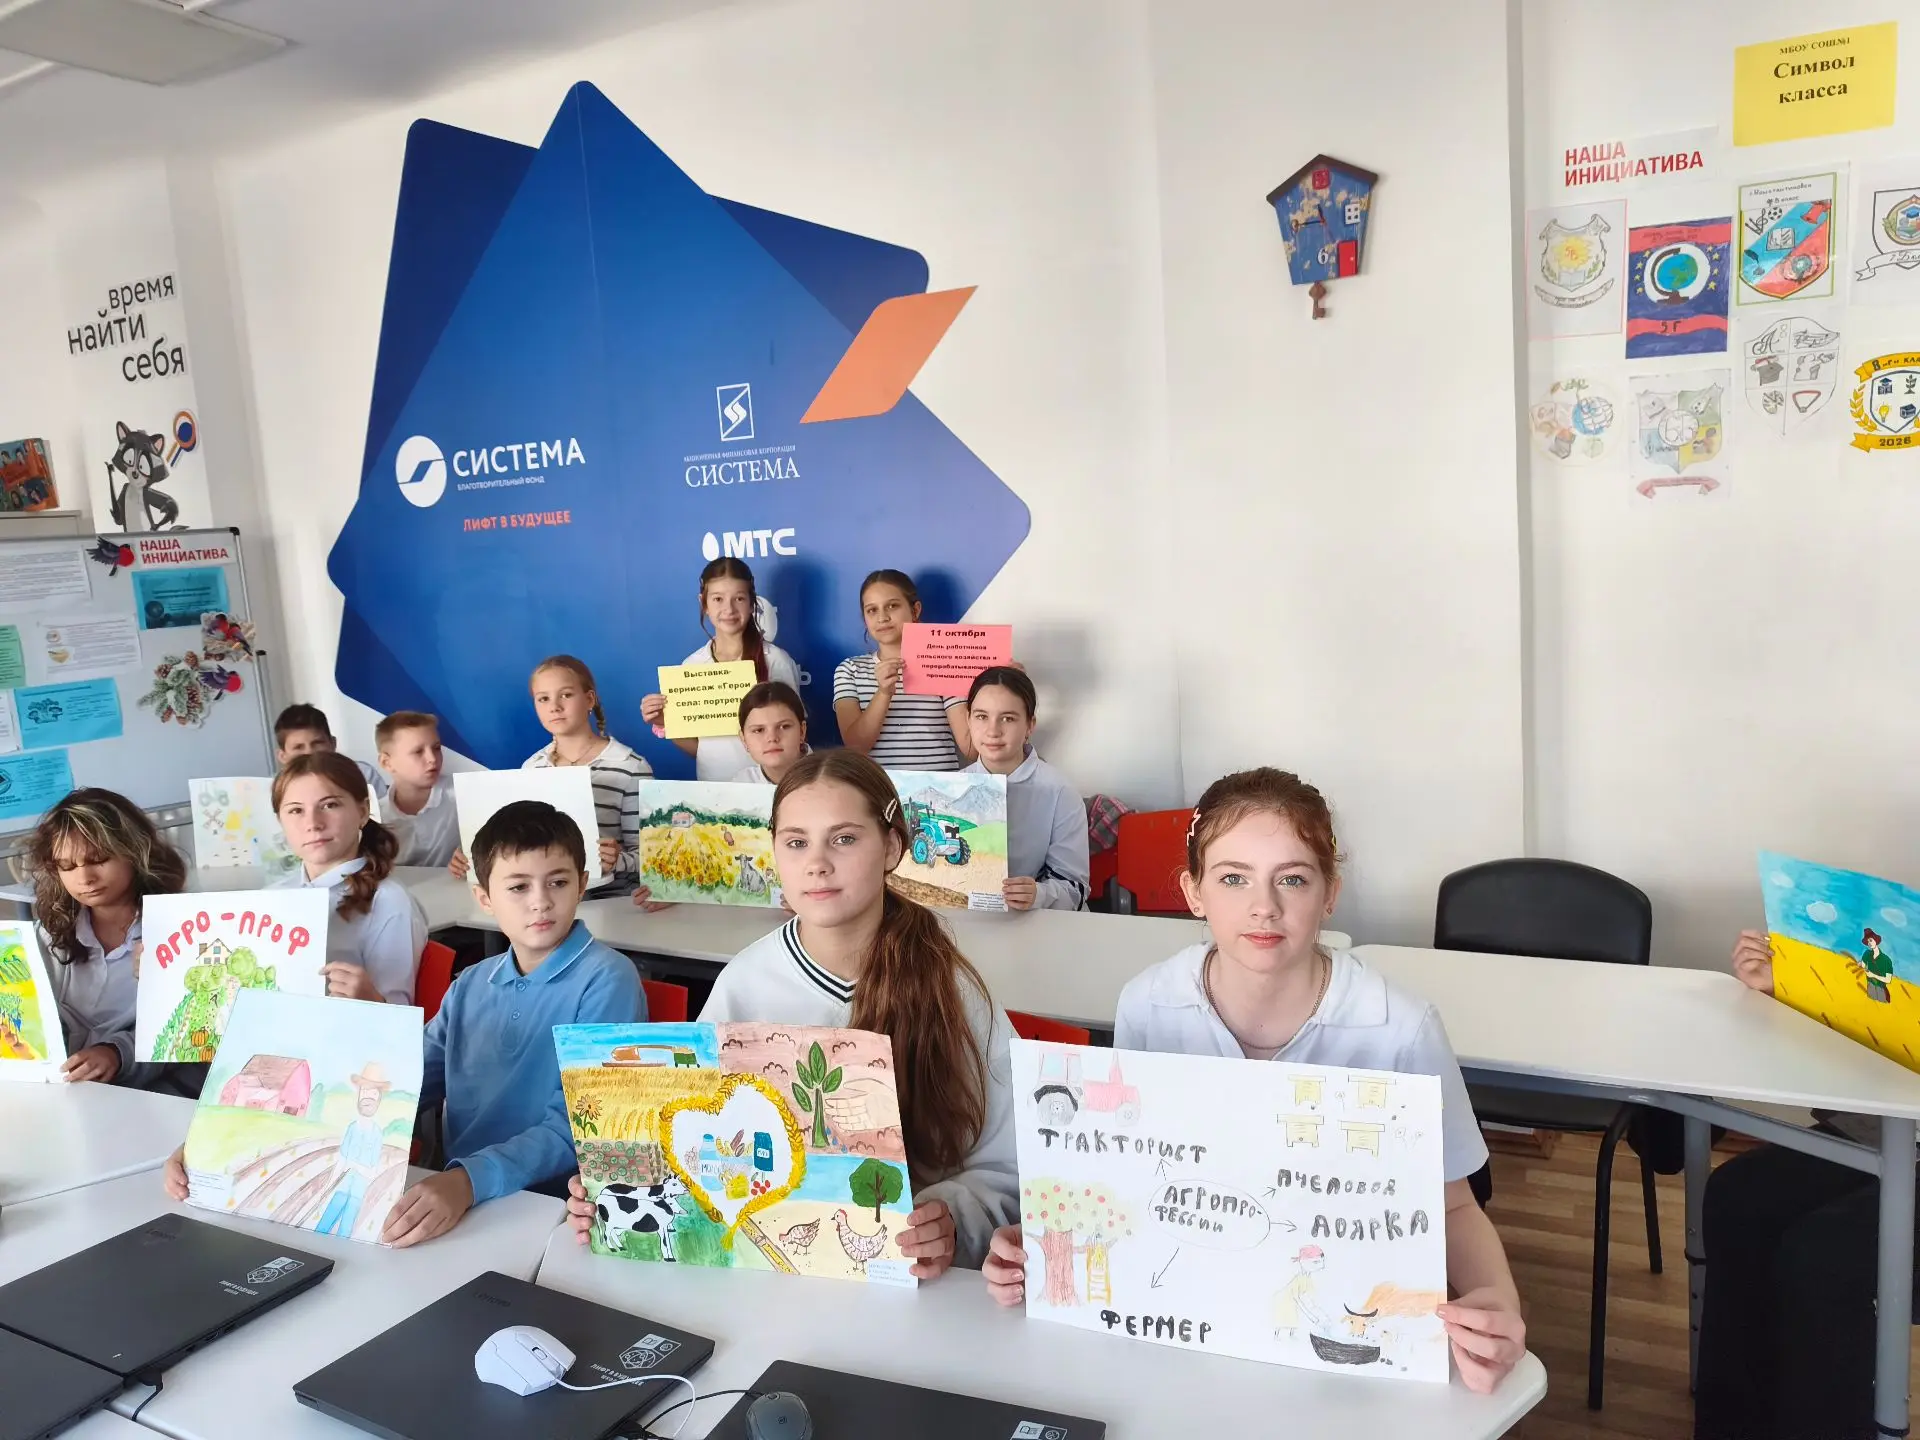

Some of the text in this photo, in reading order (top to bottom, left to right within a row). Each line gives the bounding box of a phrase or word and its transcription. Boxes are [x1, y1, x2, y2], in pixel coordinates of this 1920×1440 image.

[1773, 56, 1855, 79] Символ
[1779, 83, 1848, 104] класса
[1565, 141, 1626, 167] НАША
[1565, 151, 1704, 187] ИНИЦИАТИВА
[1317, 247, 1329, 265] 6
[108, 275, 175, 315] время
[67, 308, 146, 355] найти
[122, 337, 185, 382] себя
[452, 437, 586, 477] СИСТЕМА
[685, 456, 801, 488] СИСТЕМА
[463, 510, 572, 532] ЛИФТ В БУДУЩЕЕ
[140, 538, 181, 552] НАША
[142, 547, 229, 564] ИНИЦИАТИВА
[723, 527, 797, 559] МТС
[945, 629, 986, 638] октября
[683, 669, 733, 679] Выставка-
[668, 685, 715, 695] вернисаж
[1038, 1128, 1207, 1164] ТРАКТОРИСТ
[1154, 1205, 1224, 1233] ФЕССИИ
[1100, 1309, 1212, 1344] ФЕРМЕР
